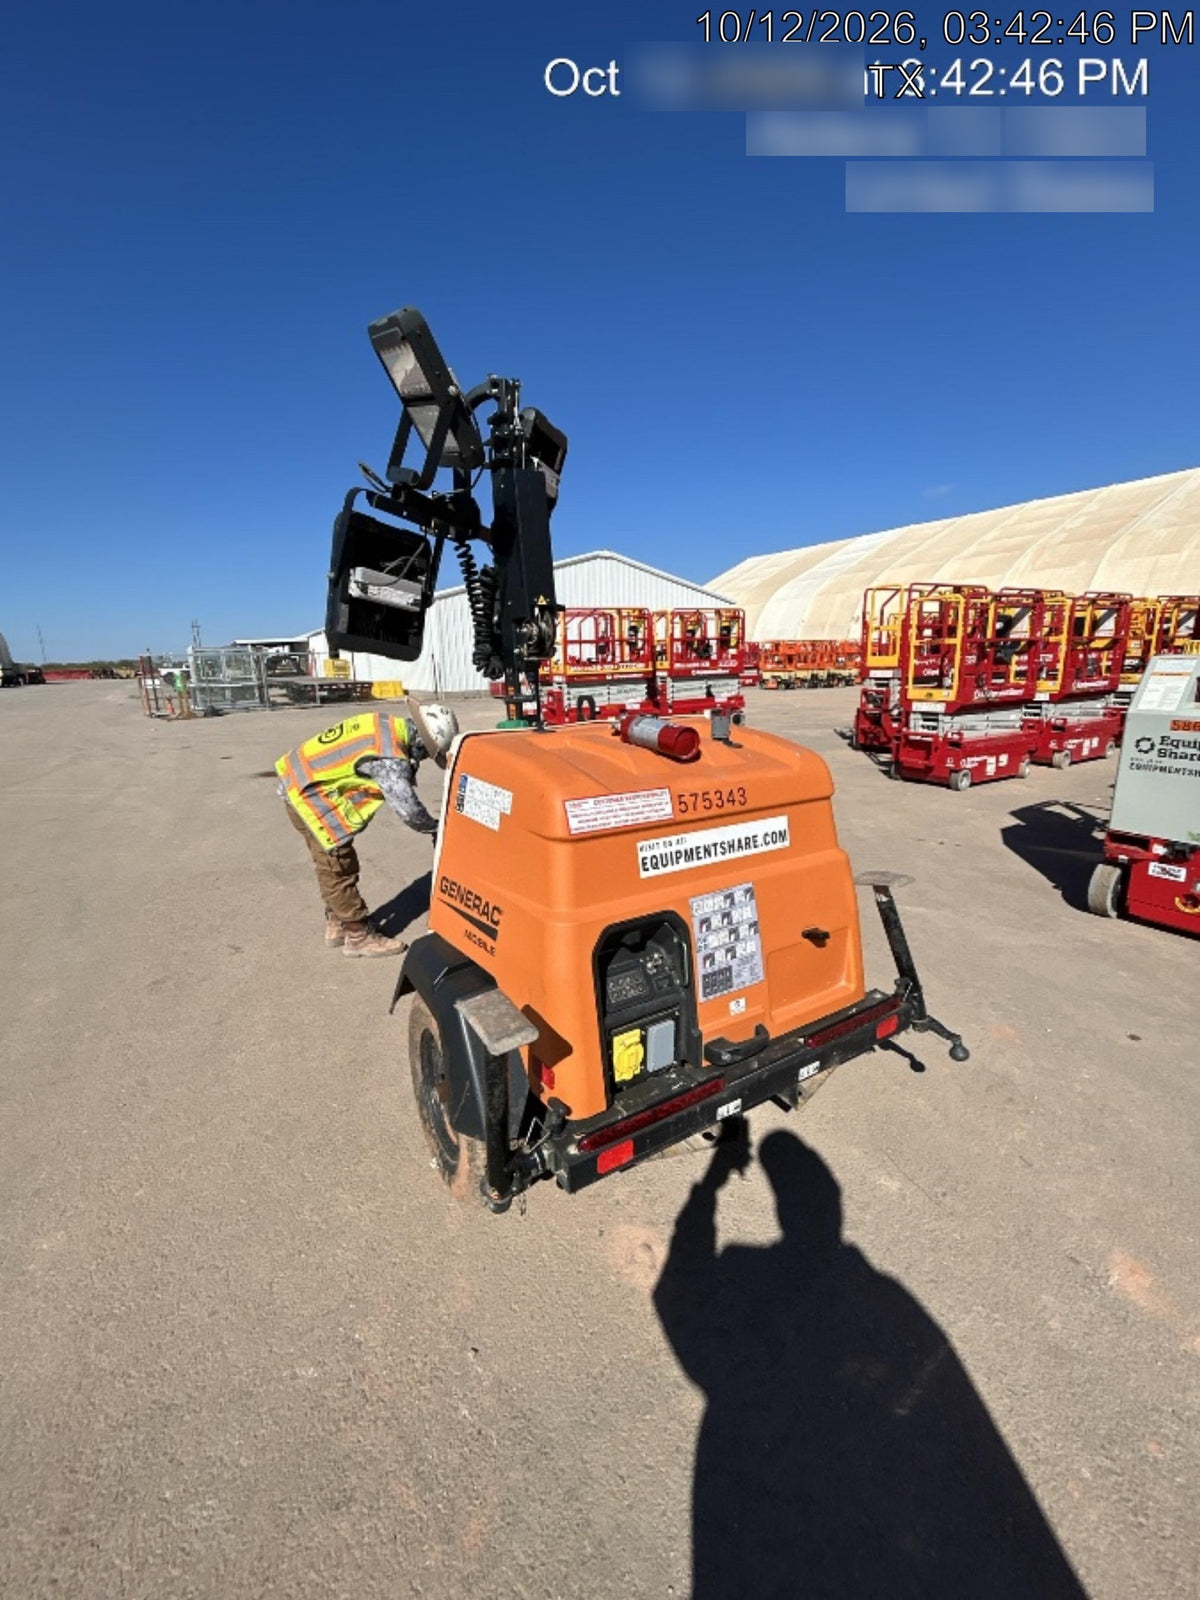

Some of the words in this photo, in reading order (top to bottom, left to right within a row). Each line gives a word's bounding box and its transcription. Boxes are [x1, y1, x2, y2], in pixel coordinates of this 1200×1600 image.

[1158, 735, 1200, 751] Equi
[677, 787, 748, 814] 575343
[640, 829, 788, 872] EQUIPMENTSHARE.COM
[440, 876, 503, 927] GENERAC
